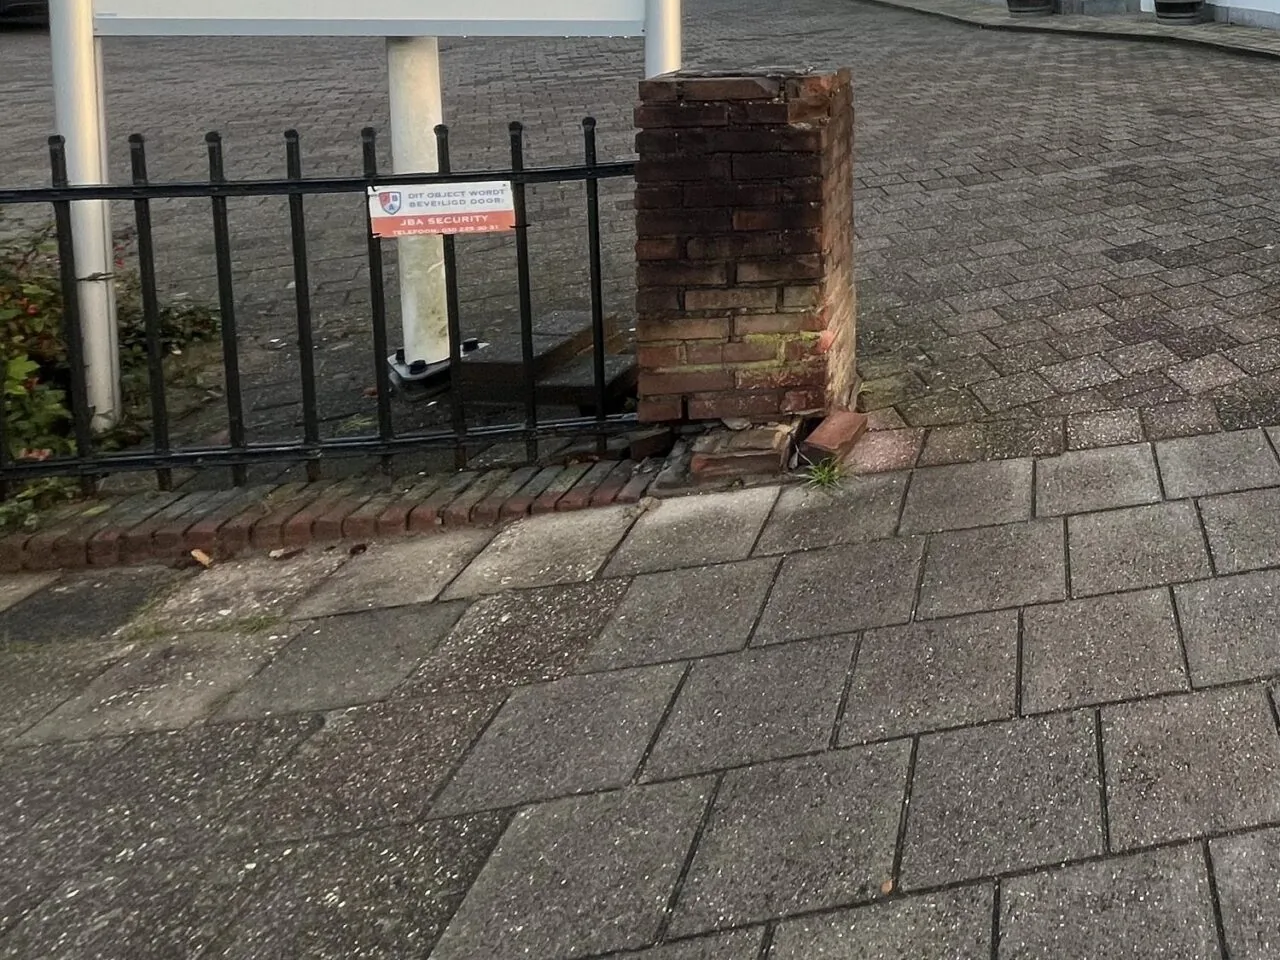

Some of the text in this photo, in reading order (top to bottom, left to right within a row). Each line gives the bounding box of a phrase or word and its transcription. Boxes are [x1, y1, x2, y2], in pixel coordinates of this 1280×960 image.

[427, 191, 466, 199] OBJECT
[469, 189, 505, 197] WORDT
[409, 199, 466, 208] BEVEILIGD
[400, 215, 488, 227] JBA SECURITY
